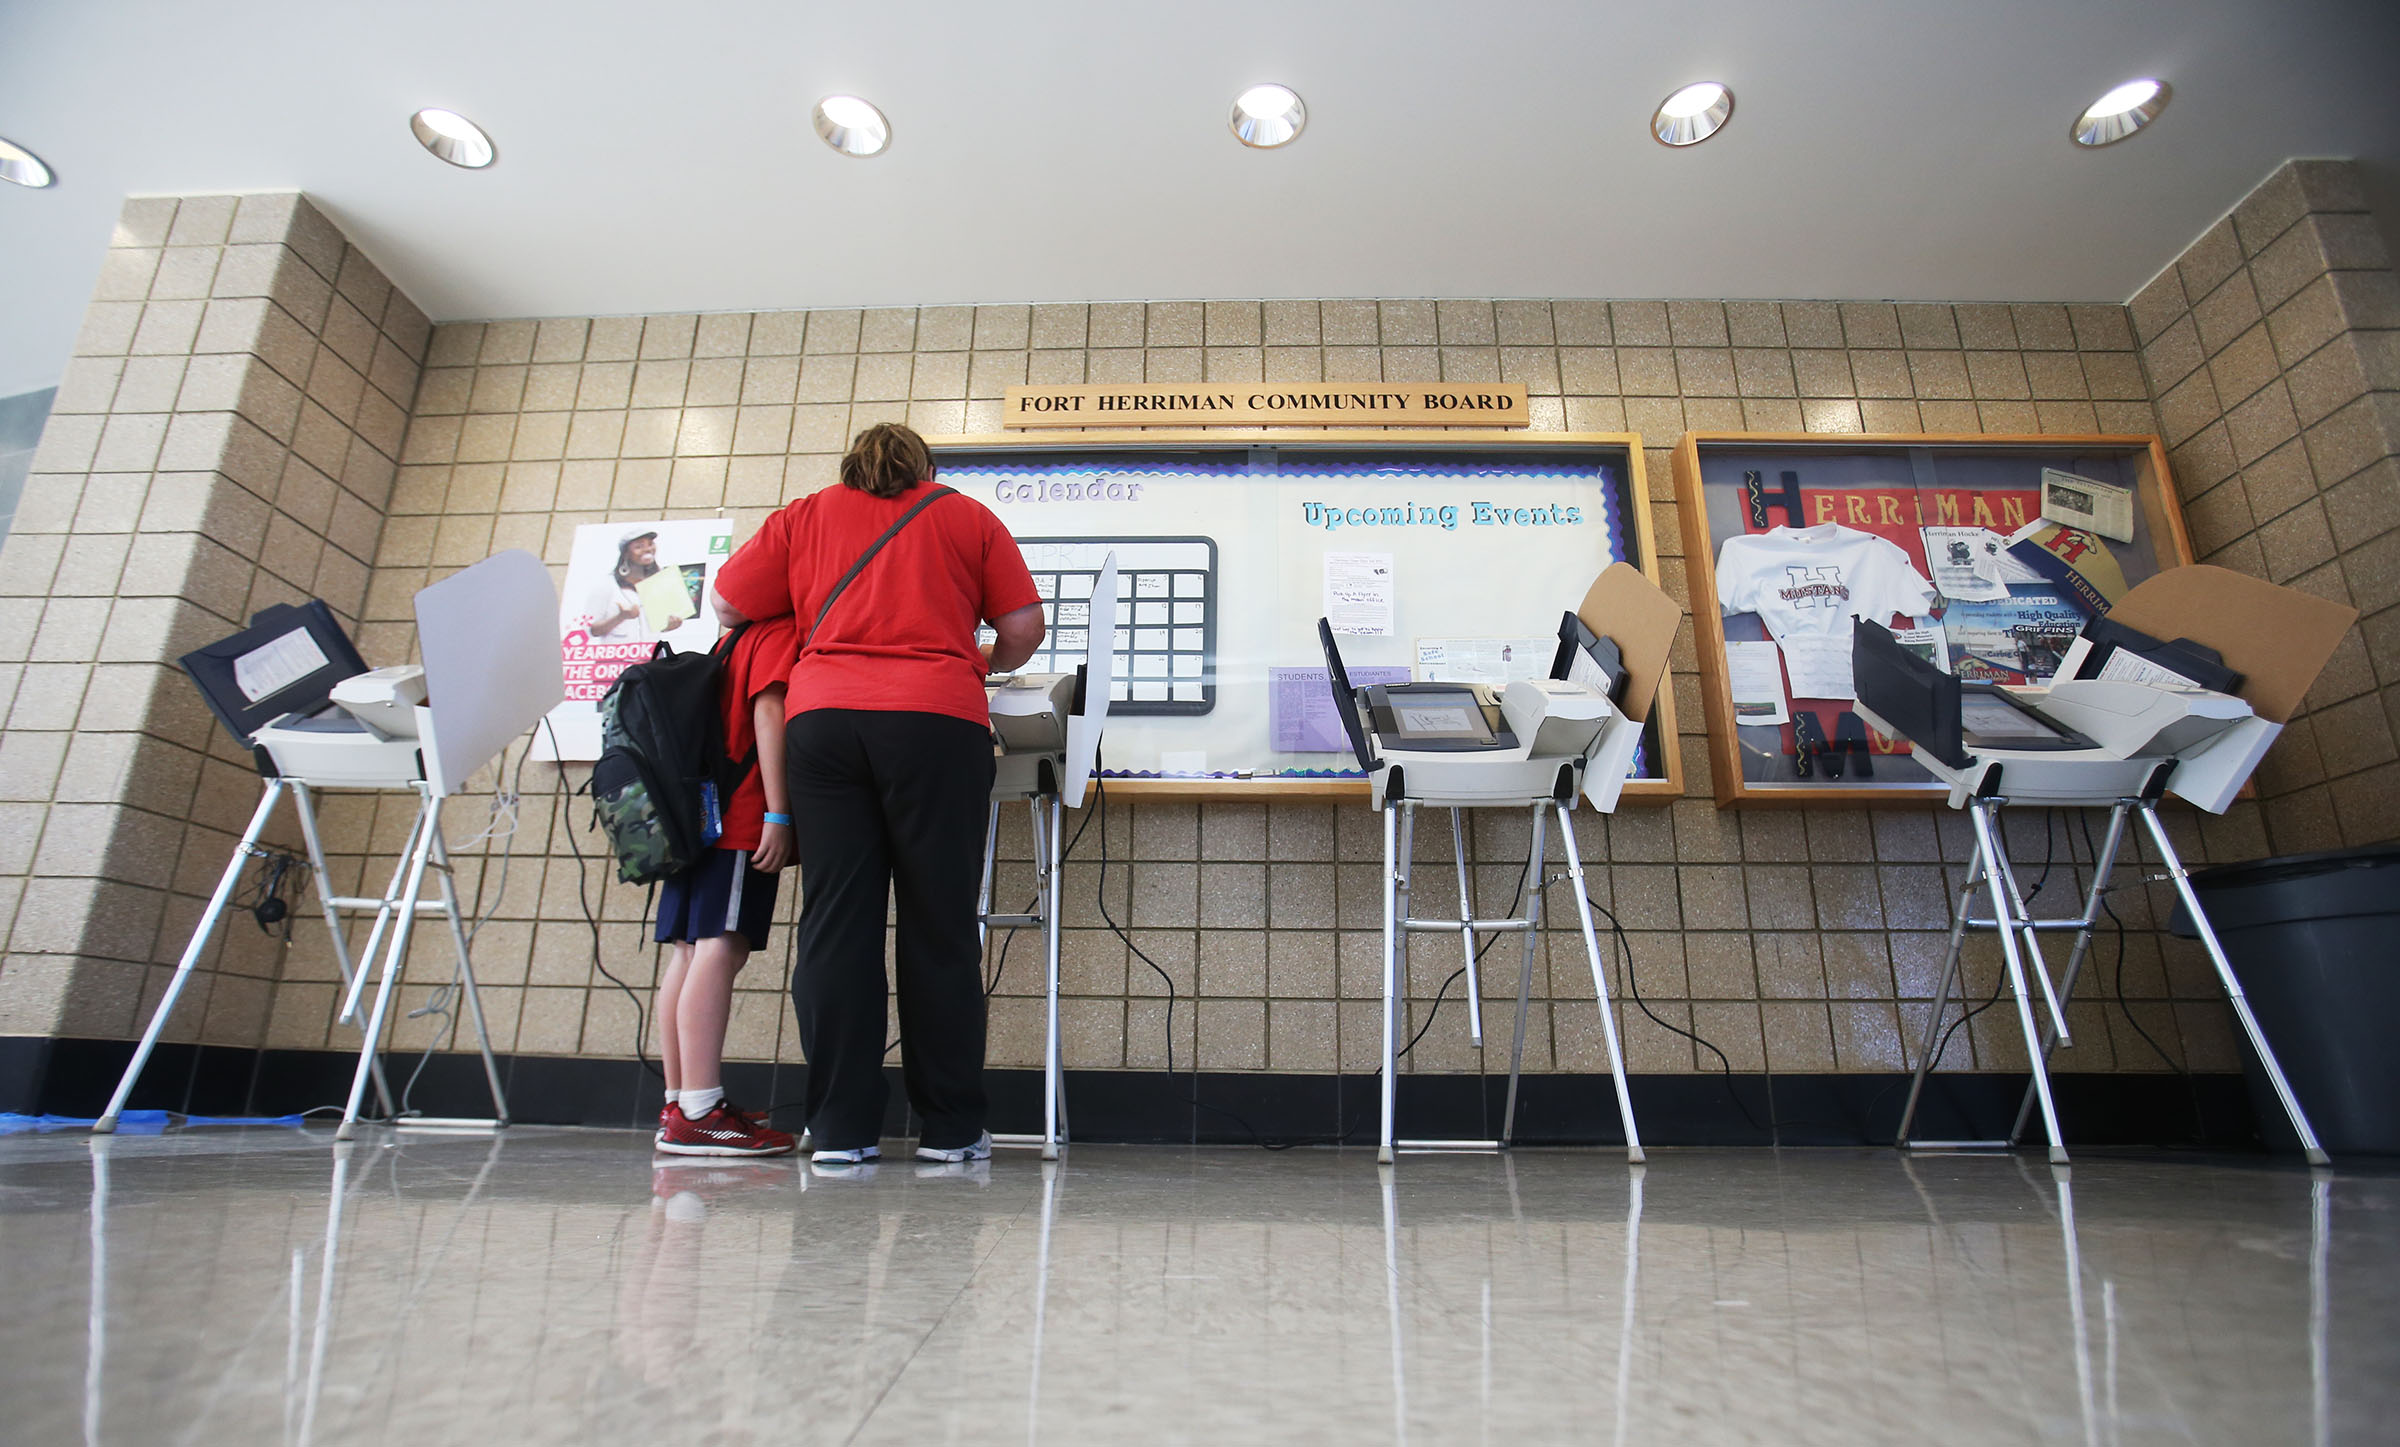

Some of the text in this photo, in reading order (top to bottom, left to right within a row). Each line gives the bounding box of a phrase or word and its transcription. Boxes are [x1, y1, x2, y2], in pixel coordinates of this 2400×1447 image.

[1020, 393, 1514, 413] FORT HERRIMAN COMMUNITY BOARD
[995, 478, 1145, 504] Calendar
[1304, 501, 1585, 531] Upcoming Events
[2065, 570, 2110, 616] HERRIM
[2017, 611, 2042, 620] High
[2044, 610, 2081, 620] Quality
[562, 644, 653, 660] YEARBOOK
[1987, 651, 2011, 659] Caring
[562, 665, 632, 679] THE ORI
[564, 685, 612, 699] ACEB
